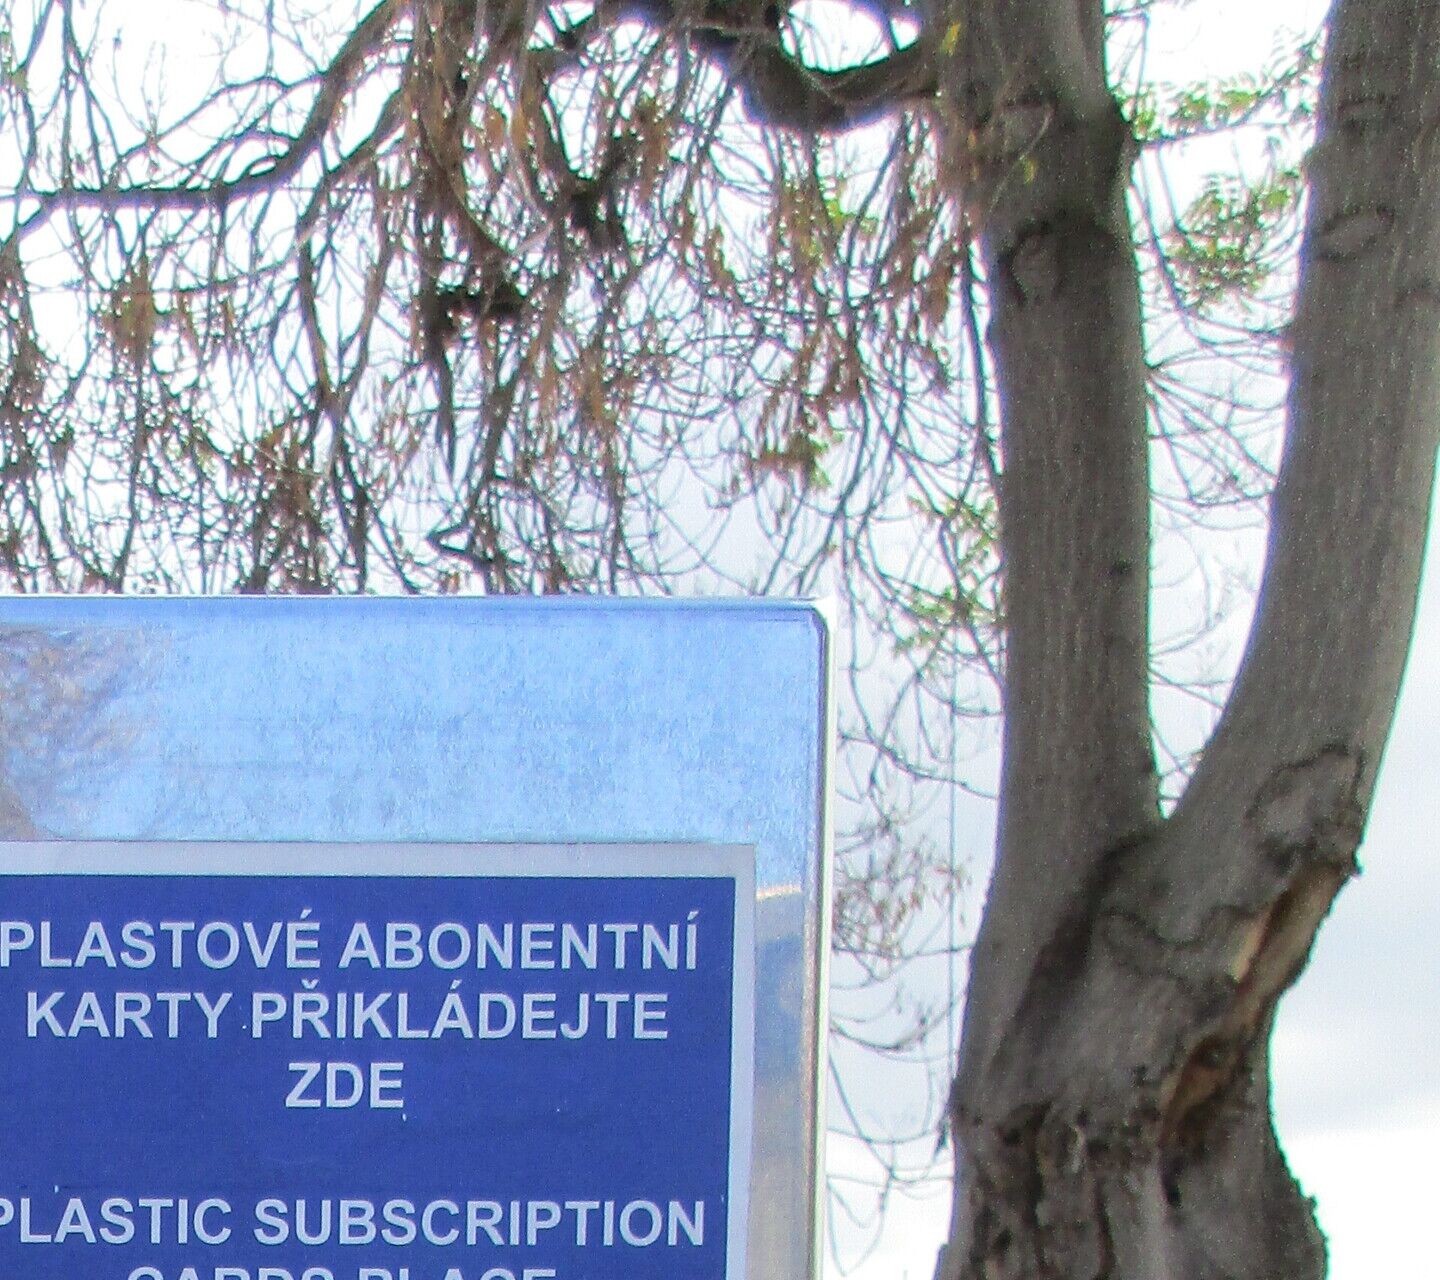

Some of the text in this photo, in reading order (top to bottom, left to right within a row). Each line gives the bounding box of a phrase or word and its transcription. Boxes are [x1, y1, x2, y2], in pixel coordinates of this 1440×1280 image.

[0, 909, 698, 970] PLASTOVÉ ABONENTNÍ
[27, 979, 669, 1039] KARTY PŘIKLÁDEJTE
[285, 1062, 404, 1108] ZDE
[253, 1198, 705, 1246] SUBSCRIPTION
